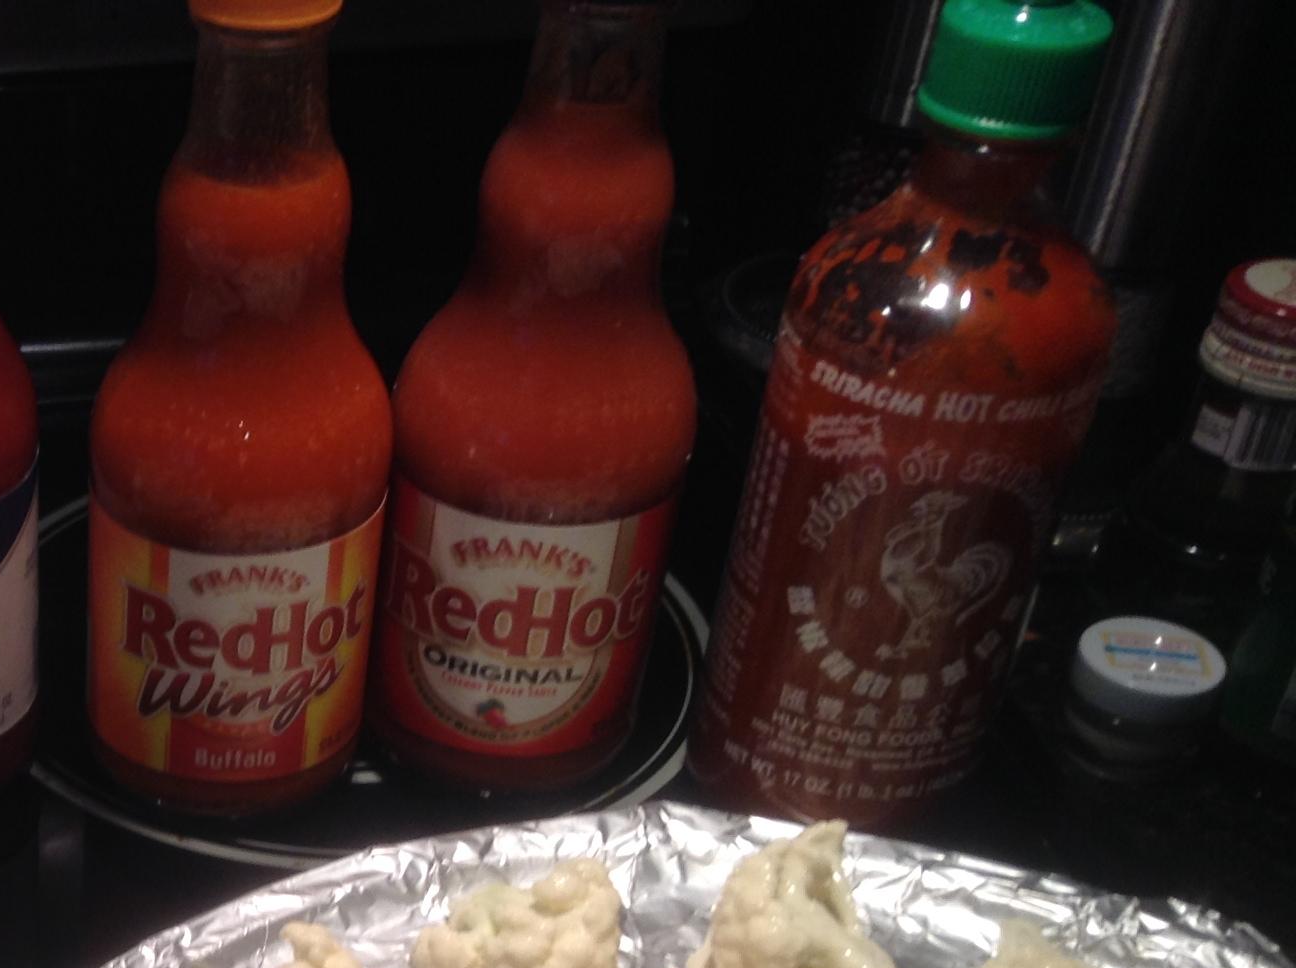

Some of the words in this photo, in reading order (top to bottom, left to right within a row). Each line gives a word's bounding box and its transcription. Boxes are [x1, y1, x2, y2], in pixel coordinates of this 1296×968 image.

[810, 360, 926, 418] SRIRACHA
[932, 391, 997, 424] HOT
[452, 536, 592, 579] FRANK'S
[190, 564, 308, 595] FRANK'S
[390, 540, 651, 658] RedHot
[122, 582, 366, 675] RedHot
[423, 643, 584, 685] ORIGINAL
[138, 655, 342, 733] Wings
[815, 722, 872, 747] FONG
[193, 745, 278, 771] Buffalo
